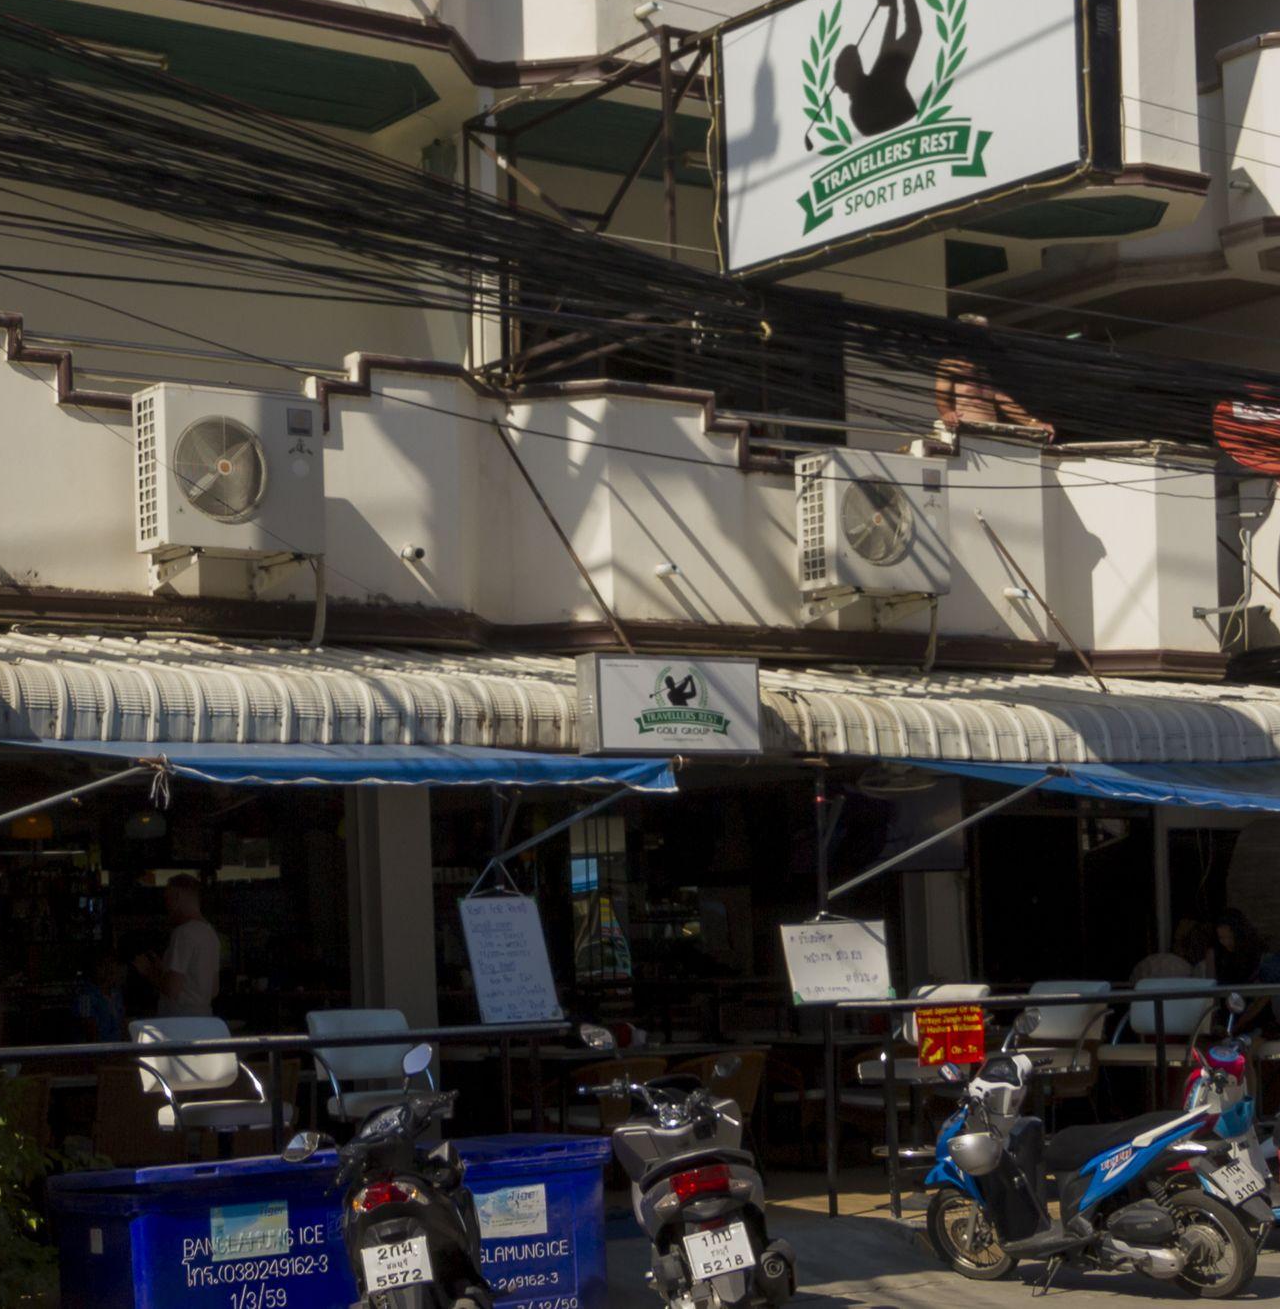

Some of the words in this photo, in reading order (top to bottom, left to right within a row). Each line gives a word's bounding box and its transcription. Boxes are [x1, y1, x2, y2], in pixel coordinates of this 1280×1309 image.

[920, 131, 959, 155] REST
[844, 182, 897, 216] SPORT
[902, 169, 936, 197] BAR
[646, 711, 696, 722] TRAVELLERS
[698, 712, 719, 723] REST
[681, 727, 711, 735] GROUP
[1234, 1181, 1258, 1200] 3107
[299, 1224, 325, 1246] ICE
[703, 1254, 744, 1274] 5218
[376, 1268, 423, 1288] 5572
